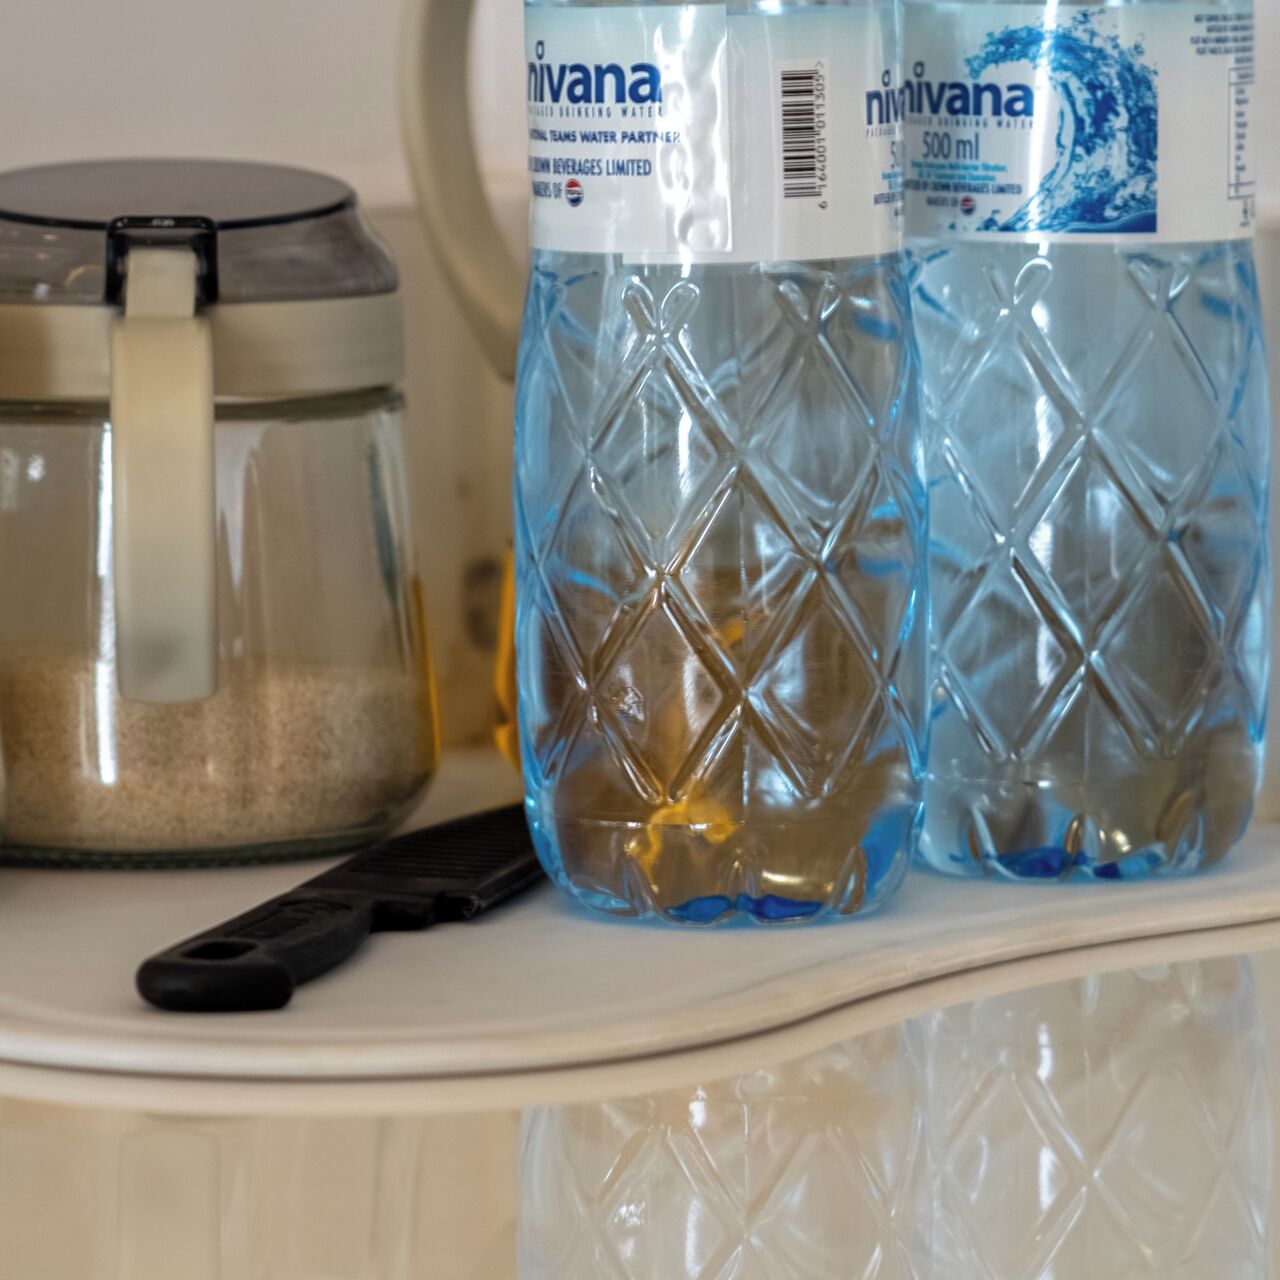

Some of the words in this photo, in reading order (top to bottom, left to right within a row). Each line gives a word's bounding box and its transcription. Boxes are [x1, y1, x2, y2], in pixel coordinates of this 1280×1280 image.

[528, 40, 663, 104] nivana
[865, 69, 904, 125] niv
[559, 106, 613, 118] DRINKING
[549, 130, 576, 143] TEAMS
[580, 131, 617, 144] WATER
[621, 131, 681, 144] PARTNER
[922, 132, 951, 160] 500
[956, 133, 980, 160] ml
[553, 158, 602, 176] BEVERAGES
[606, 159, 652, 177] LIMITED
